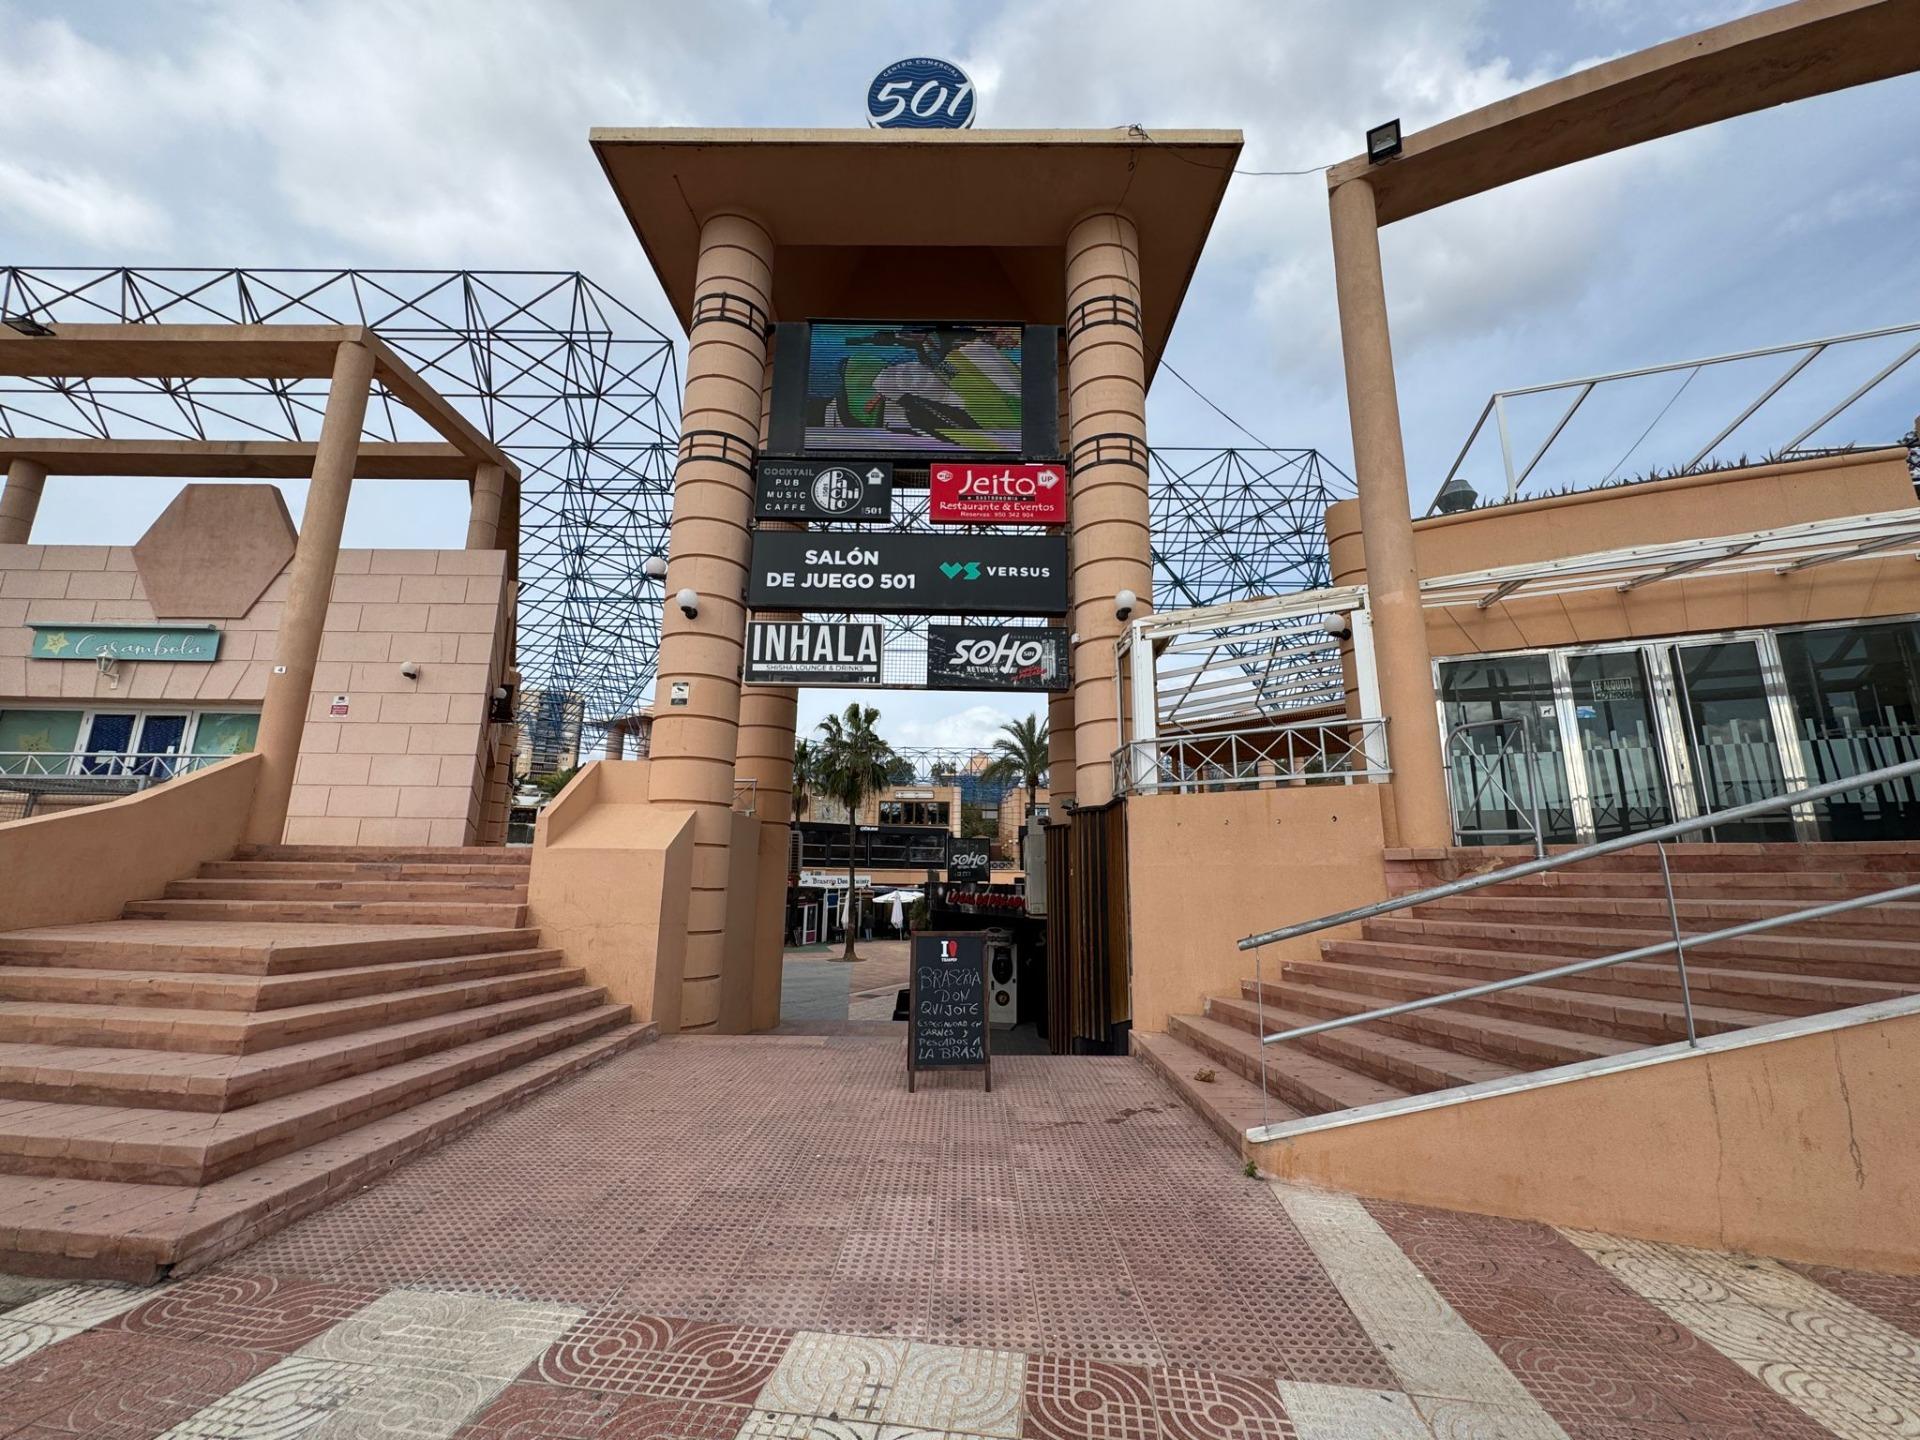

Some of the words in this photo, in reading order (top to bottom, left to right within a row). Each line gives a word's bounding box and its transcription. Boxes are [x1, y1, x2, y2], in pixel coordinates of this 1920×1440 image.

[883, 61, 913, 77] CENTRO
[916, 60, 959, 77] COMERCIAL
[872, 80, 973, 122] 501
[764, 468, 815, 477] COCKTAIL
[958, 470, 1036, 495] Jeito
[767, 491, 806, 499] MUSIC
[765, 503, 806, 511] CAFFE
[940, 501, 1000, 511] Restaurante
[1002, 503, 1011, 511] &
[1014, 503, 1054, 511] Eventos
[805, 547, 879, 566] SALÓN
[987, 566, 1050, 578] VERSUS
[766, 572, 796, 588] DE
[801, 573, 874, 589] JUEGO
[880, 574, 916, 589] 501
[75, 633, 205, 656] Carambola
[752, 624, 878, 662] INHALA
[949, 633, 1043, 674] SOHO
[951, 851, 988, 868] SOHO
[941, 941, 949, 957] I
[934, 989, 970, 1003] DON
[921, 1001, 979, 1016] QUIJOTE
[918, 1047, 935, 1059] LA
[938, 1046, 984, 1059] BRASA
